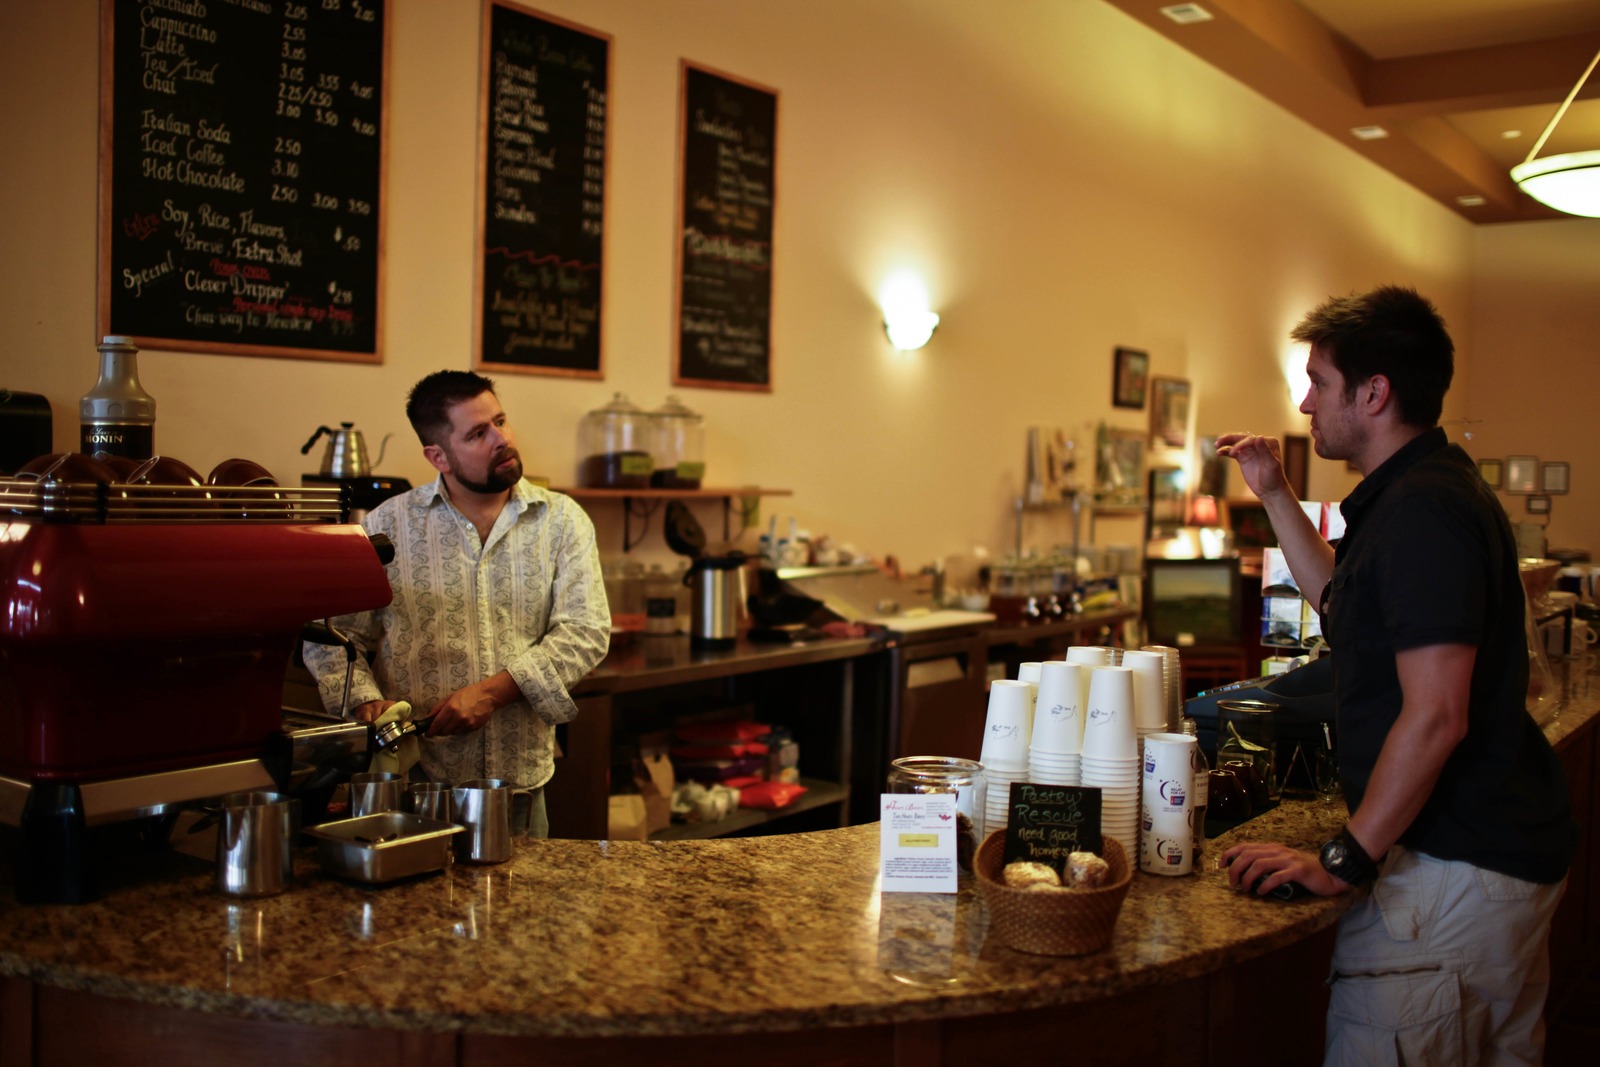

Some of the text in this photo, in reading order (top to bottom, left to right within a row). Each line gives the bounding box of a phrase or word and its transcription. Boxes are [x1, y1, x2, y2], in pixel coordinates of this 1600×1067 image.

[140, 6, 217, 44] Cappuccino
[140, 27, 186, 57] Latte
[143, 71, 177, 95] Chai
[141, 109, 190, 136] Italian
[197, 118, 231, 144] Soda
[141, 130, 177, 157] Iced
[186, 138, 225, 166] Coffee
[142, 157, 175, 181] Hot
[177, 159, 245, 193] Chocolate
[232, 238, 274, 264] Extra
[277, 244, 303, 268] Shot
[185, 269, 227, 294] Clever
[84, 434, 123, 444] MONIN
[1021, 785, 1083, 811] Pastry
[1015, 804, 1085, 827] Rescue
[1018, 827, 1078, 847] need good
